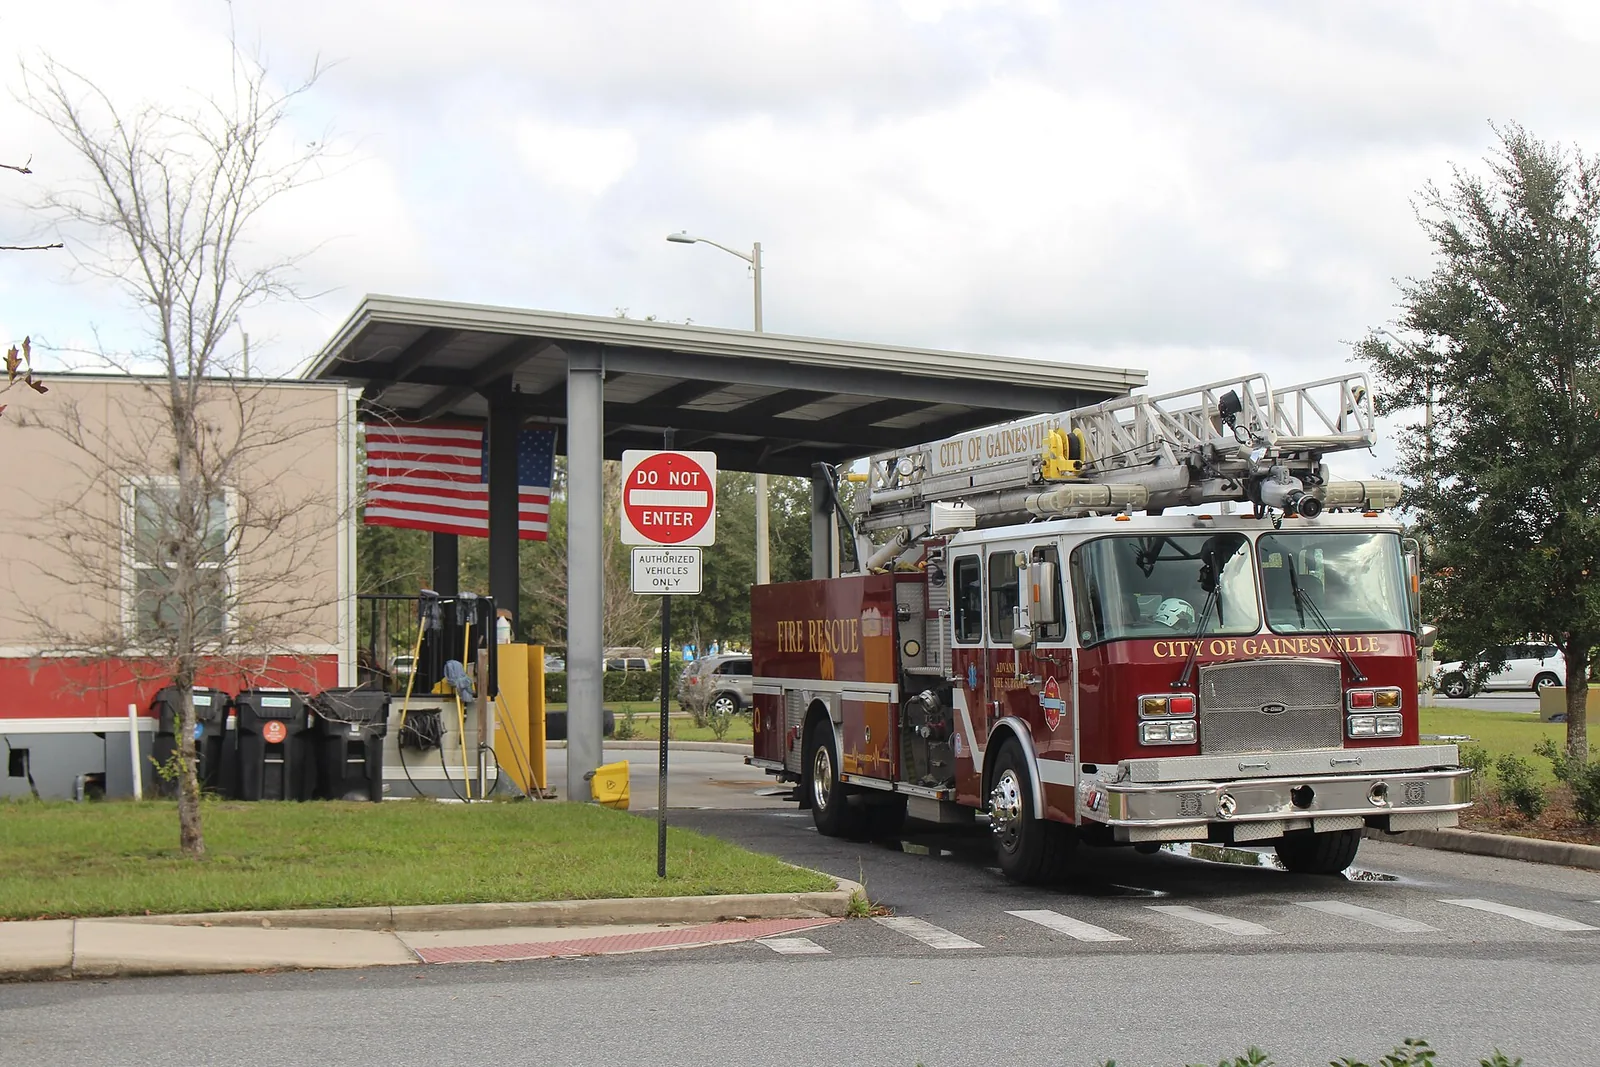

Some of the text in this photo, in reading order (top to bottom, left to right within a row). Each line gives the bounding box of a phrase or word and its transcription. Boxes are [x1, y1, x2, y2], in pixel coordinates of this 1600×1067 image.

[940, 440, 963, 468] CITY
[968, 436, 982, 463] OF
[637, 470, 700, 486] DO NOT
[642, 511, 693, 526] ENTER
[639, 555, 695, 564] AUTHORIZED
[645, 567, 688, 575] VEHICLES
[652, 578, 681, 586] ONLY
[777, 619, 859, 653] FIRE RESCUE
[1153, 636, 1380, 658] CITY OF GAINESVILLE
[996, 662, 1023, 673] ADVAND
